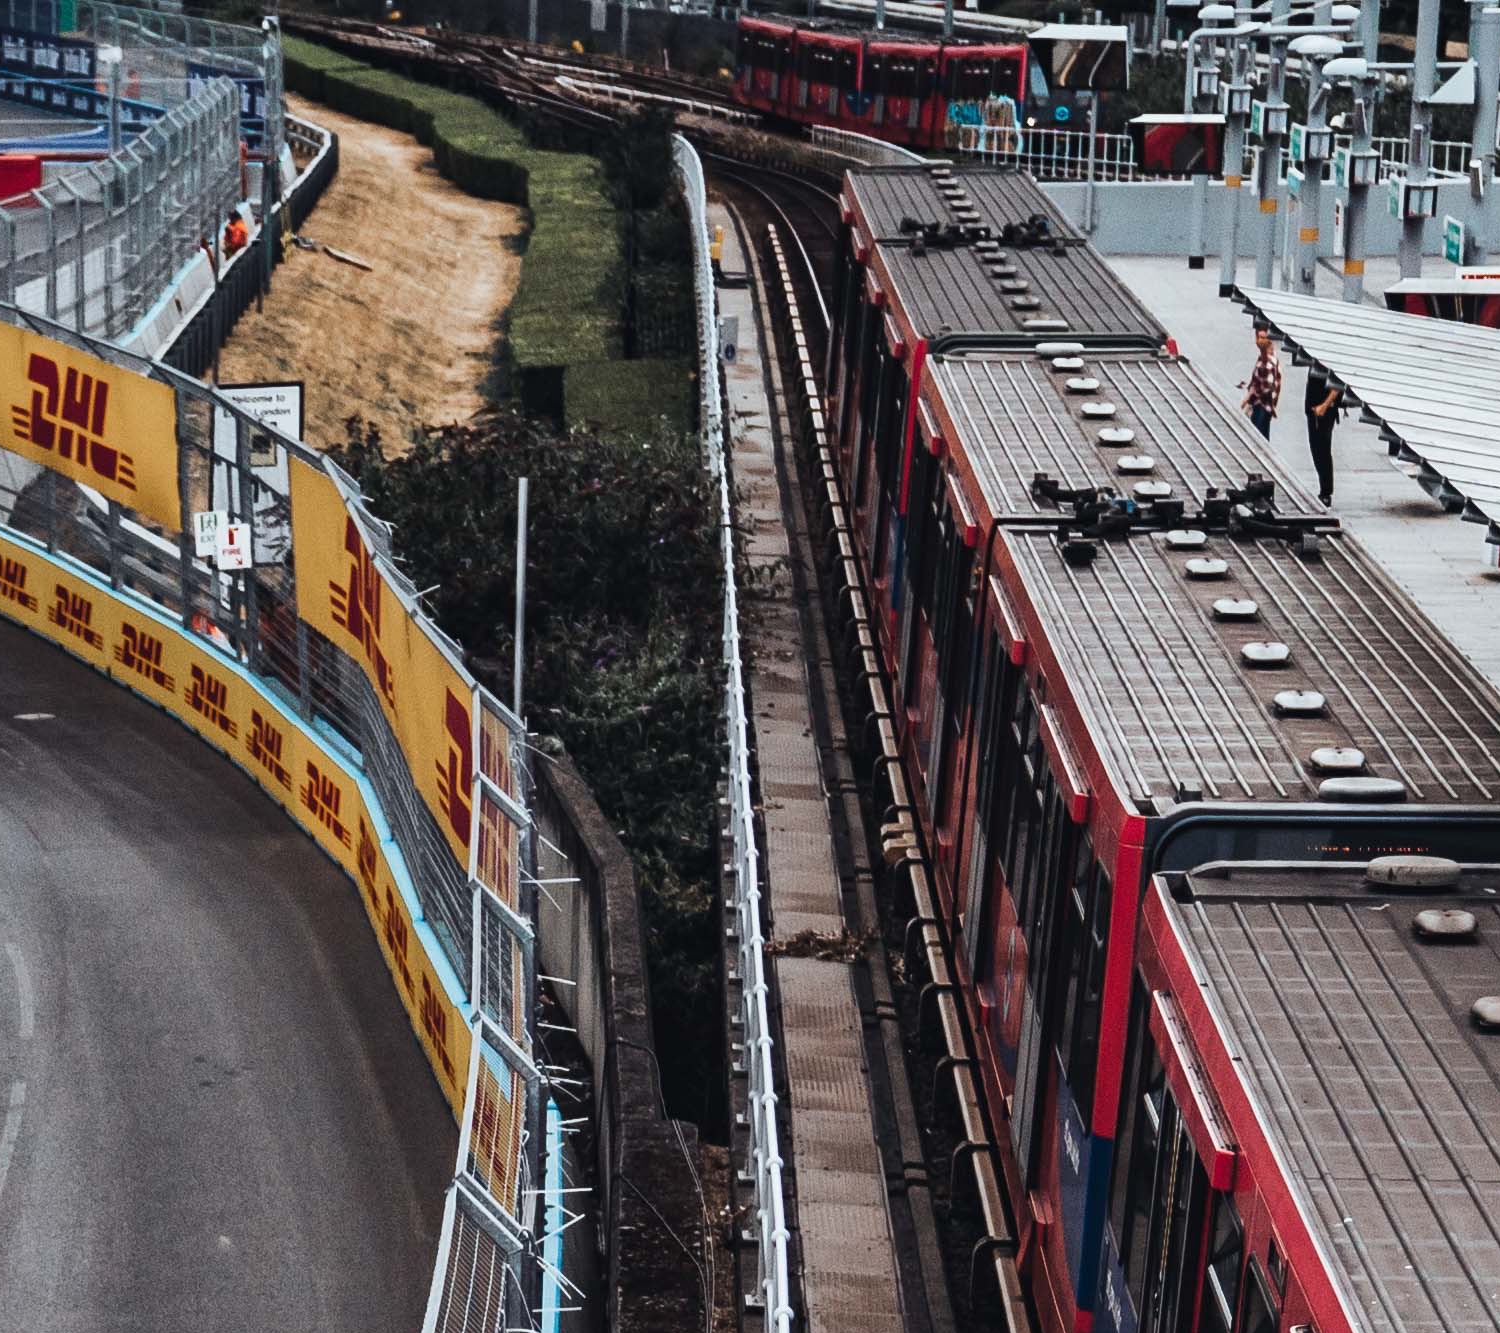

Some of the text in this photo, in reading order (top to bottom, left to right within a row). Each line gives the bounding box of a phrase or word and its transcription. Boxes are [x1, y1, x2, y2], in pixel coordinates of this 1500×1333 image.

[18, 352, 130, 488] DHL
[222, 547, 241, 556] FIRE
[50, 584, 103, 650] DHL
[116, 622, 174, 693] DHL
[185, 663, 237, 739] DHL
[247, 709, 291, 791] DHL
[301, 760, 351, 850] DHL
